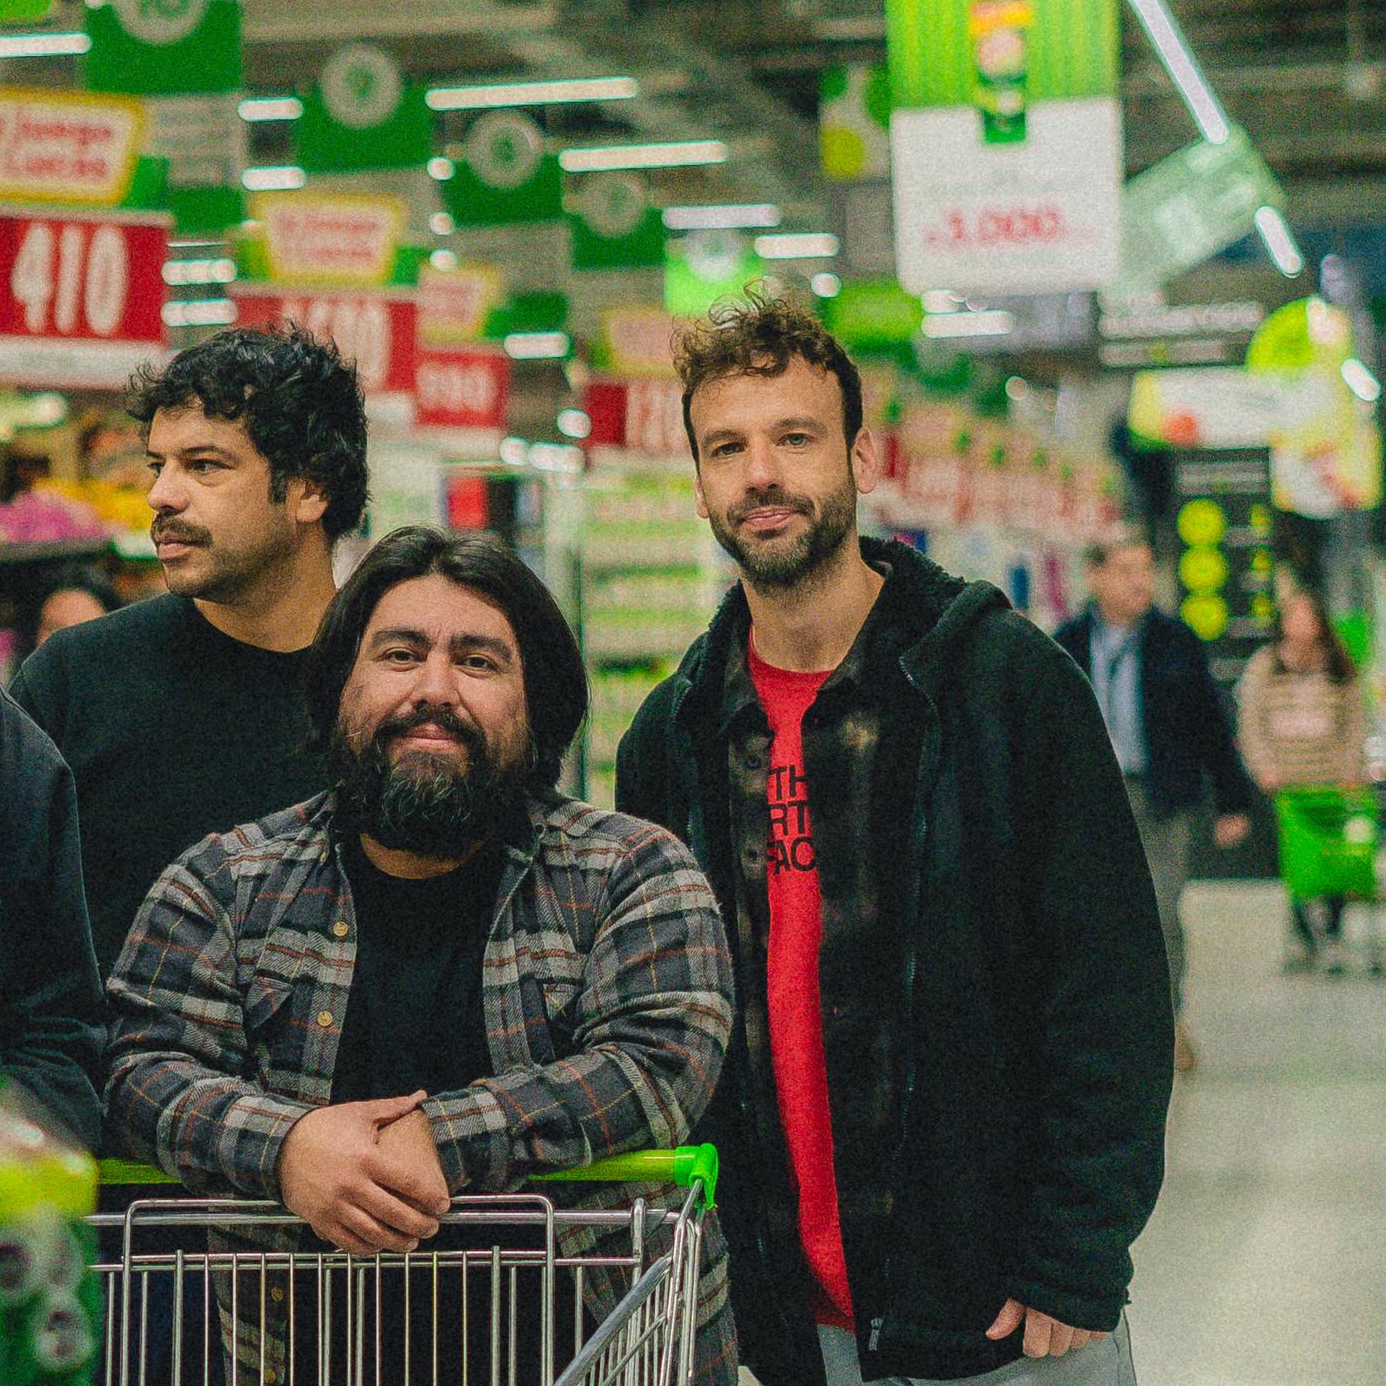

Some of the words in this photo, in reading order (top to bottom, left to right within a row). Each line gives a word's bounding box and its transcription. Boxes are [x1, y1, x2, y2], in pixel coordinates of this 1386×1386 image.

[10, 223, 129, 333] 410
[768, 764, 807, 800] TH
[768, 801, 808, 836] RT
